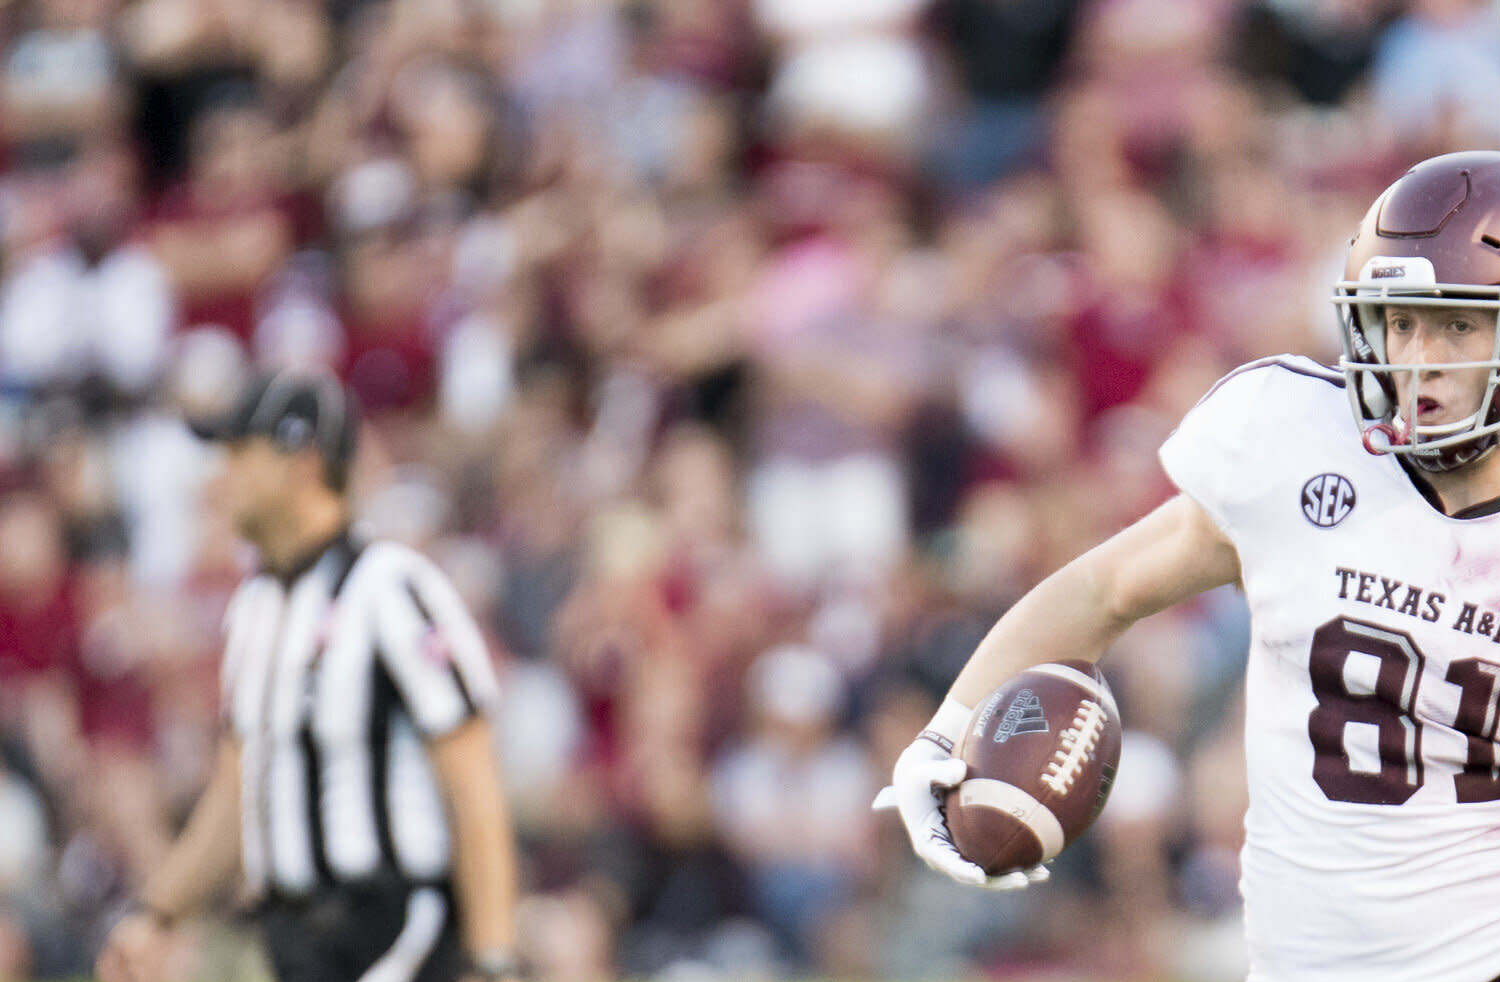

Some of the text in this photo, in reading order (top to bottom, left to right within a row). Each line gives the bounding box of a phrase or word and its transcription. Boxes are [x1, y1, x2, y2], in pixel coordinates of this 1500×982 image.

[1303, 474, 1356, 526] SEC
[1336, 567, 1446, 623] TEXAS
[993, 688, 1032, 743] adidas
